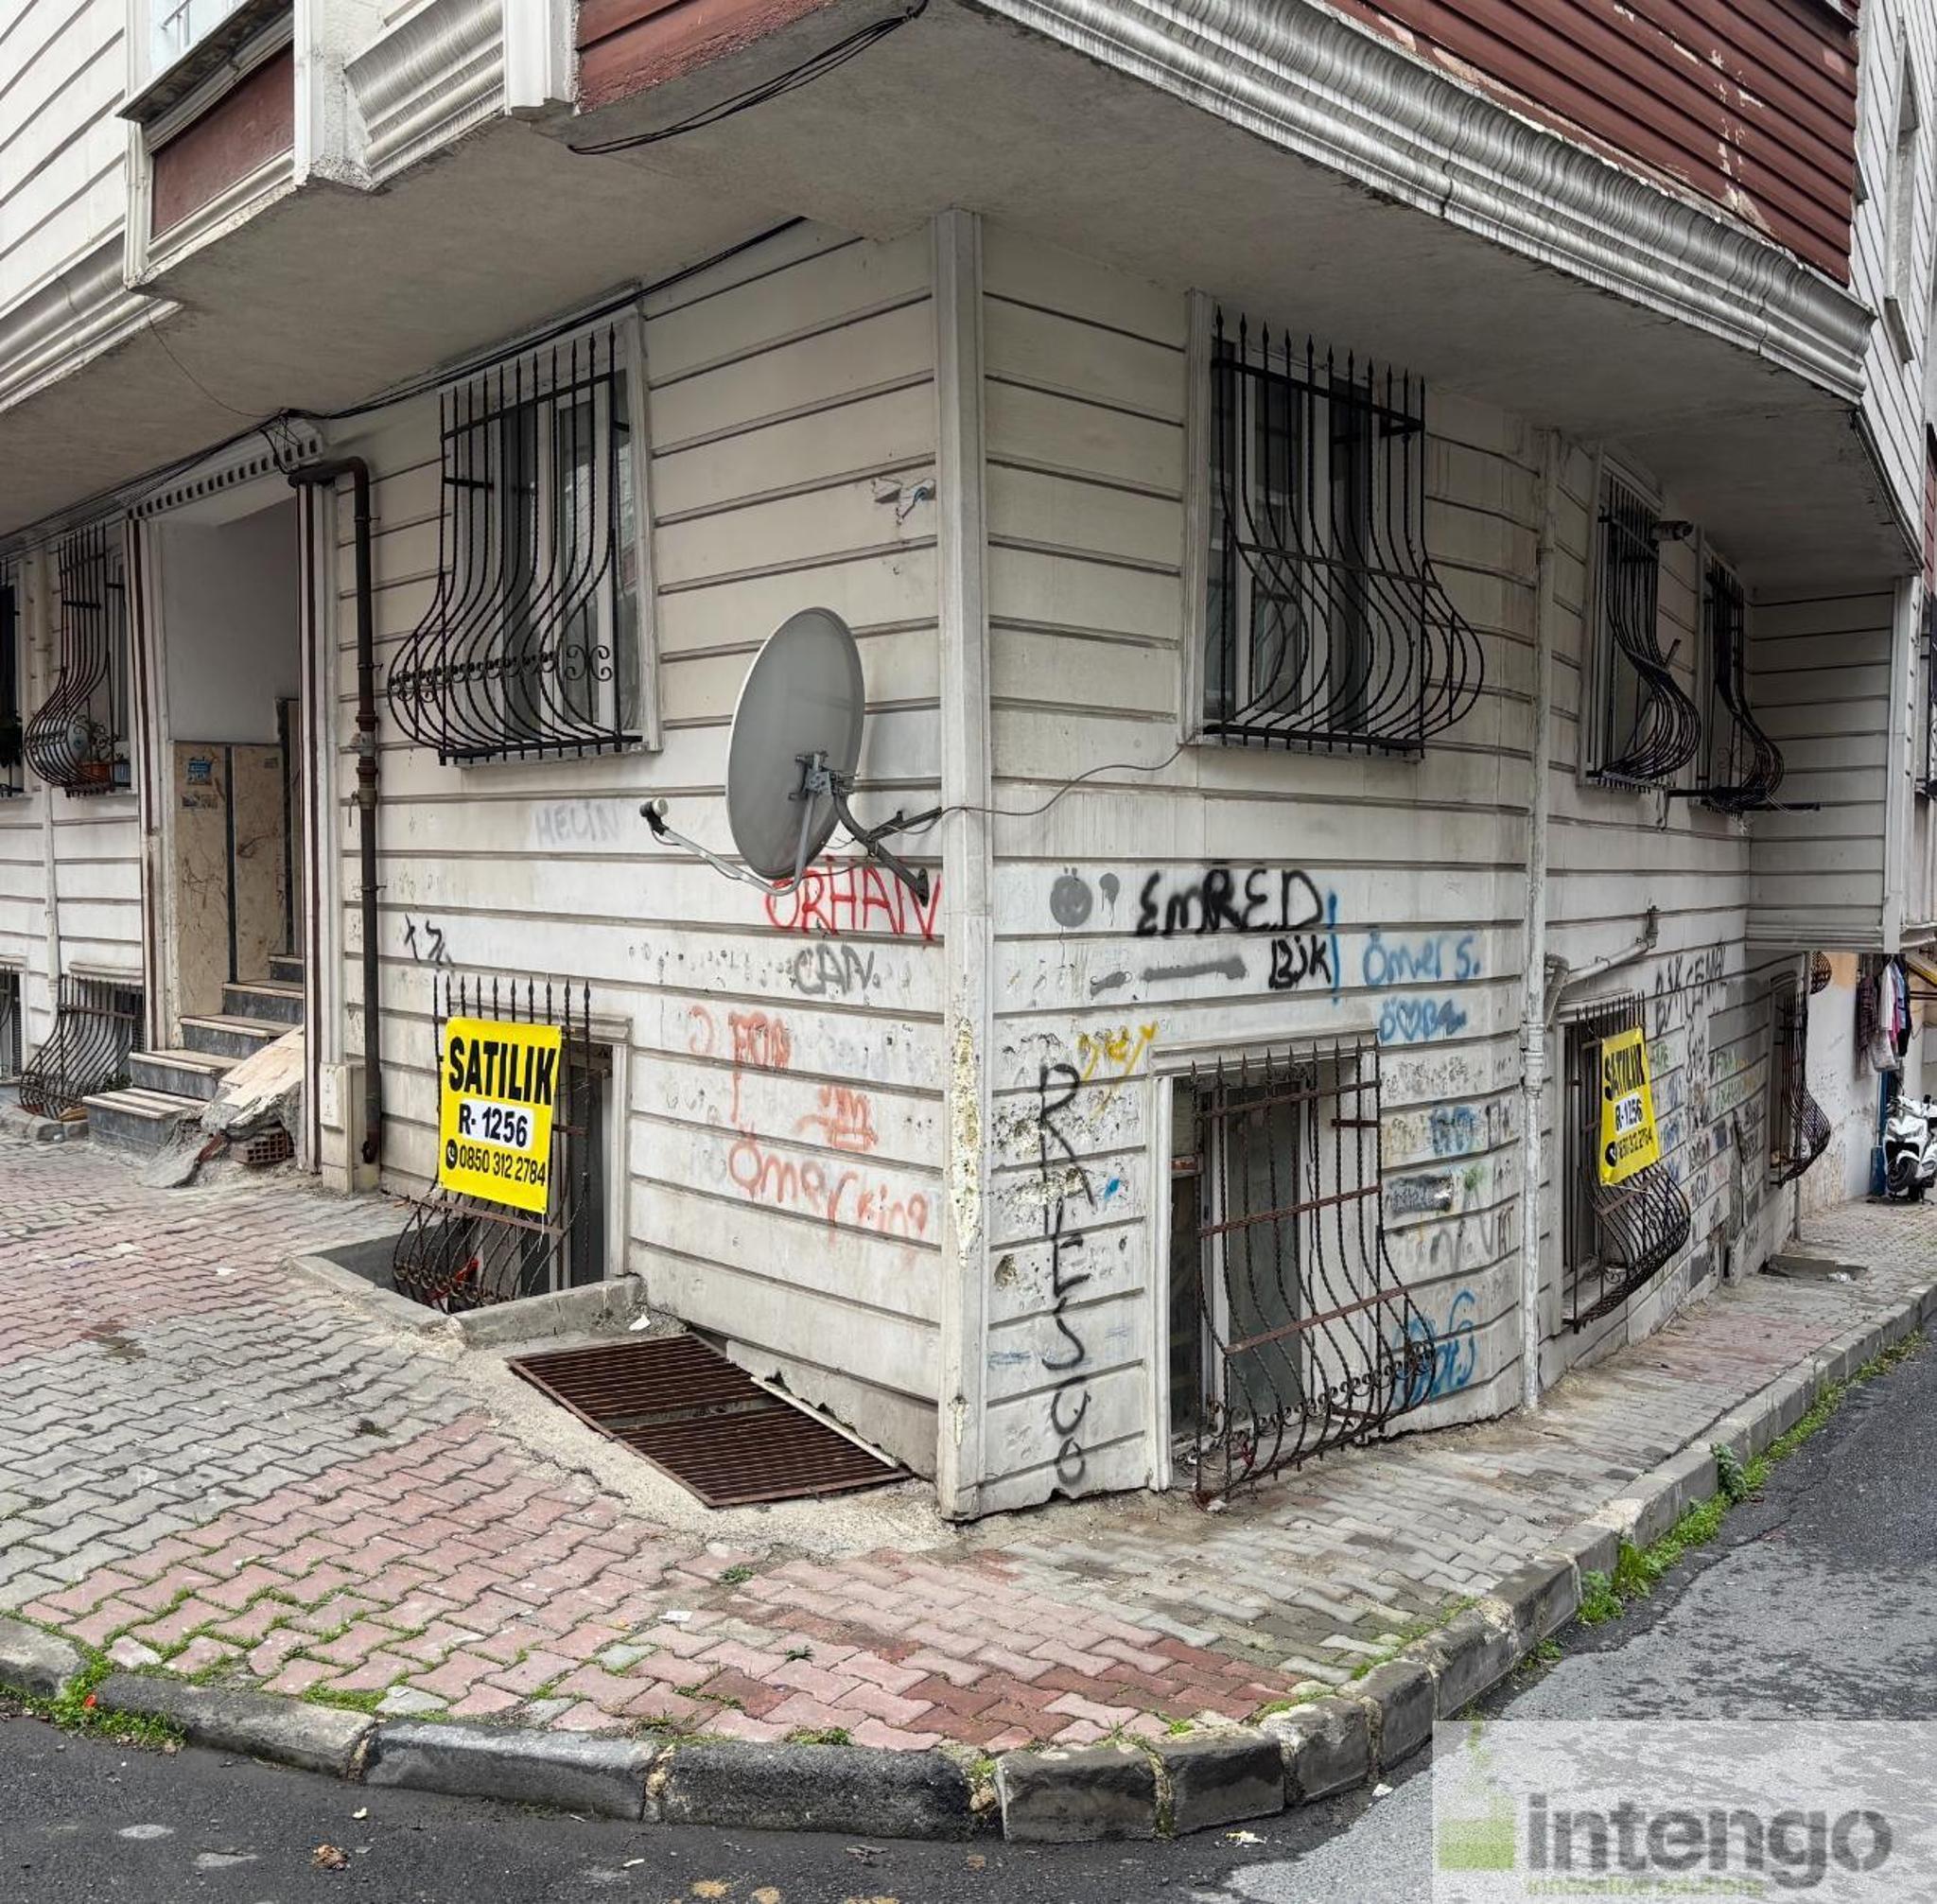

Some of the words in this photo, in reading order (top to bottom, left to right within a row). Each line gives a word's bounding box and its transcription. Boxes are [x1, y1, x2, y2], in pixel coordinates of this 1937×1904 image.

[765, 854, 940, 941] ORHAN
[448, 1036, 556, 1106] SATILIK
[1605, 1043, 1646, 1101] SATILIK
[459, 1144, 490, 1174] 0850
[492, 1151, 513, 1179] 312
[515, 1156, 547, 1186] 2784
